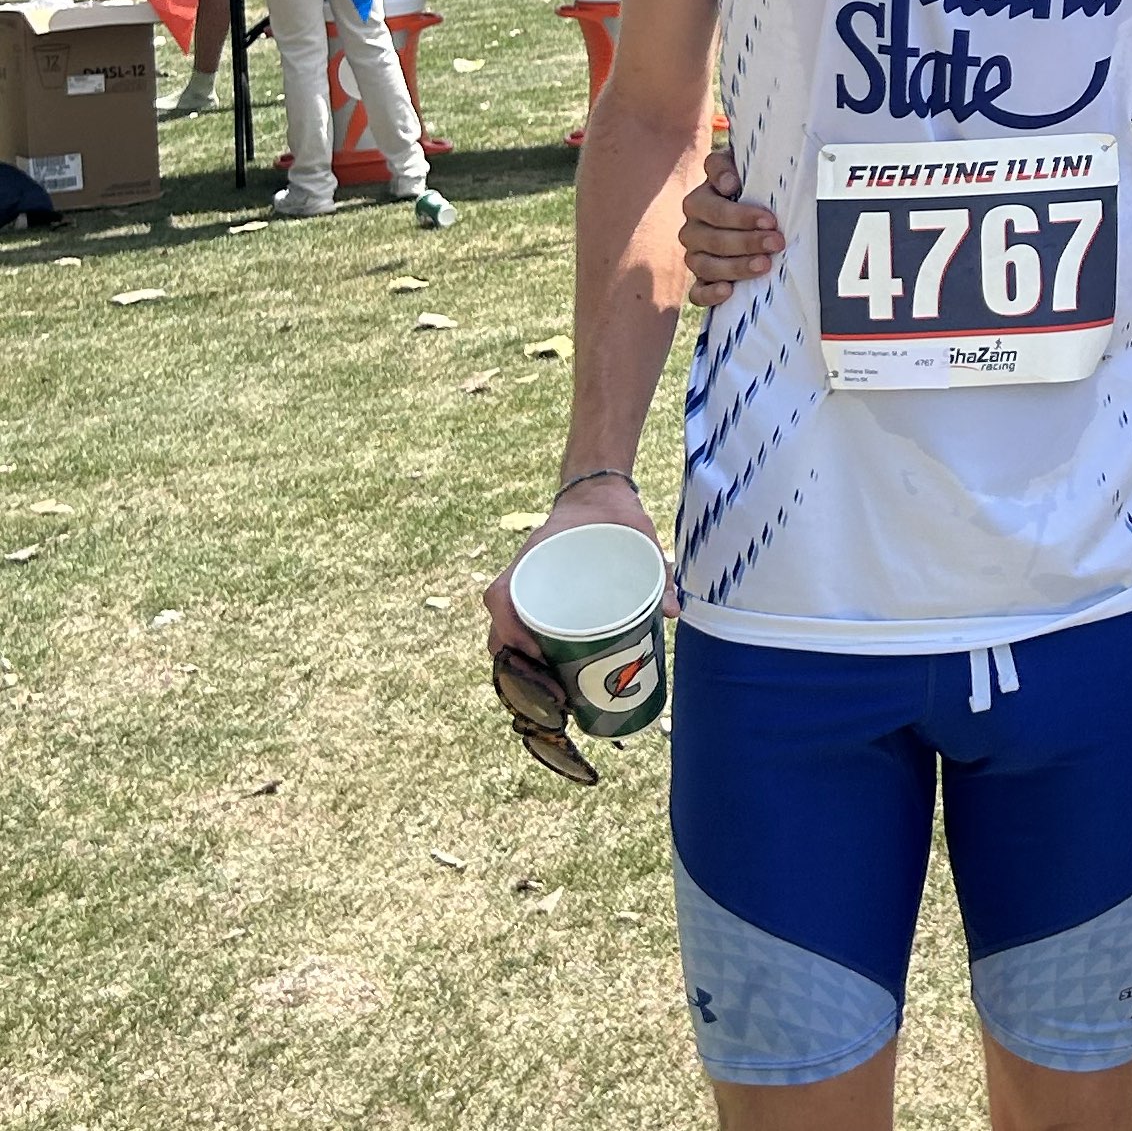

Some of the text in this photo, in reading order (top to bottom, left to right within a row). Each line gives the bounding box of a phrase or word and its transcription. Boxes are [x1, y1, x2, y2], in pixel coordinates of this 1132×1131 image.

[836, 1, 1112, 130] State
[846, 154, 1093, 188] FIGHTING ILLINI
[837, 200, 1104, 321] 4767
[914, 359, 935, 367] 4767
[980, 362, 1016, 372] racing
